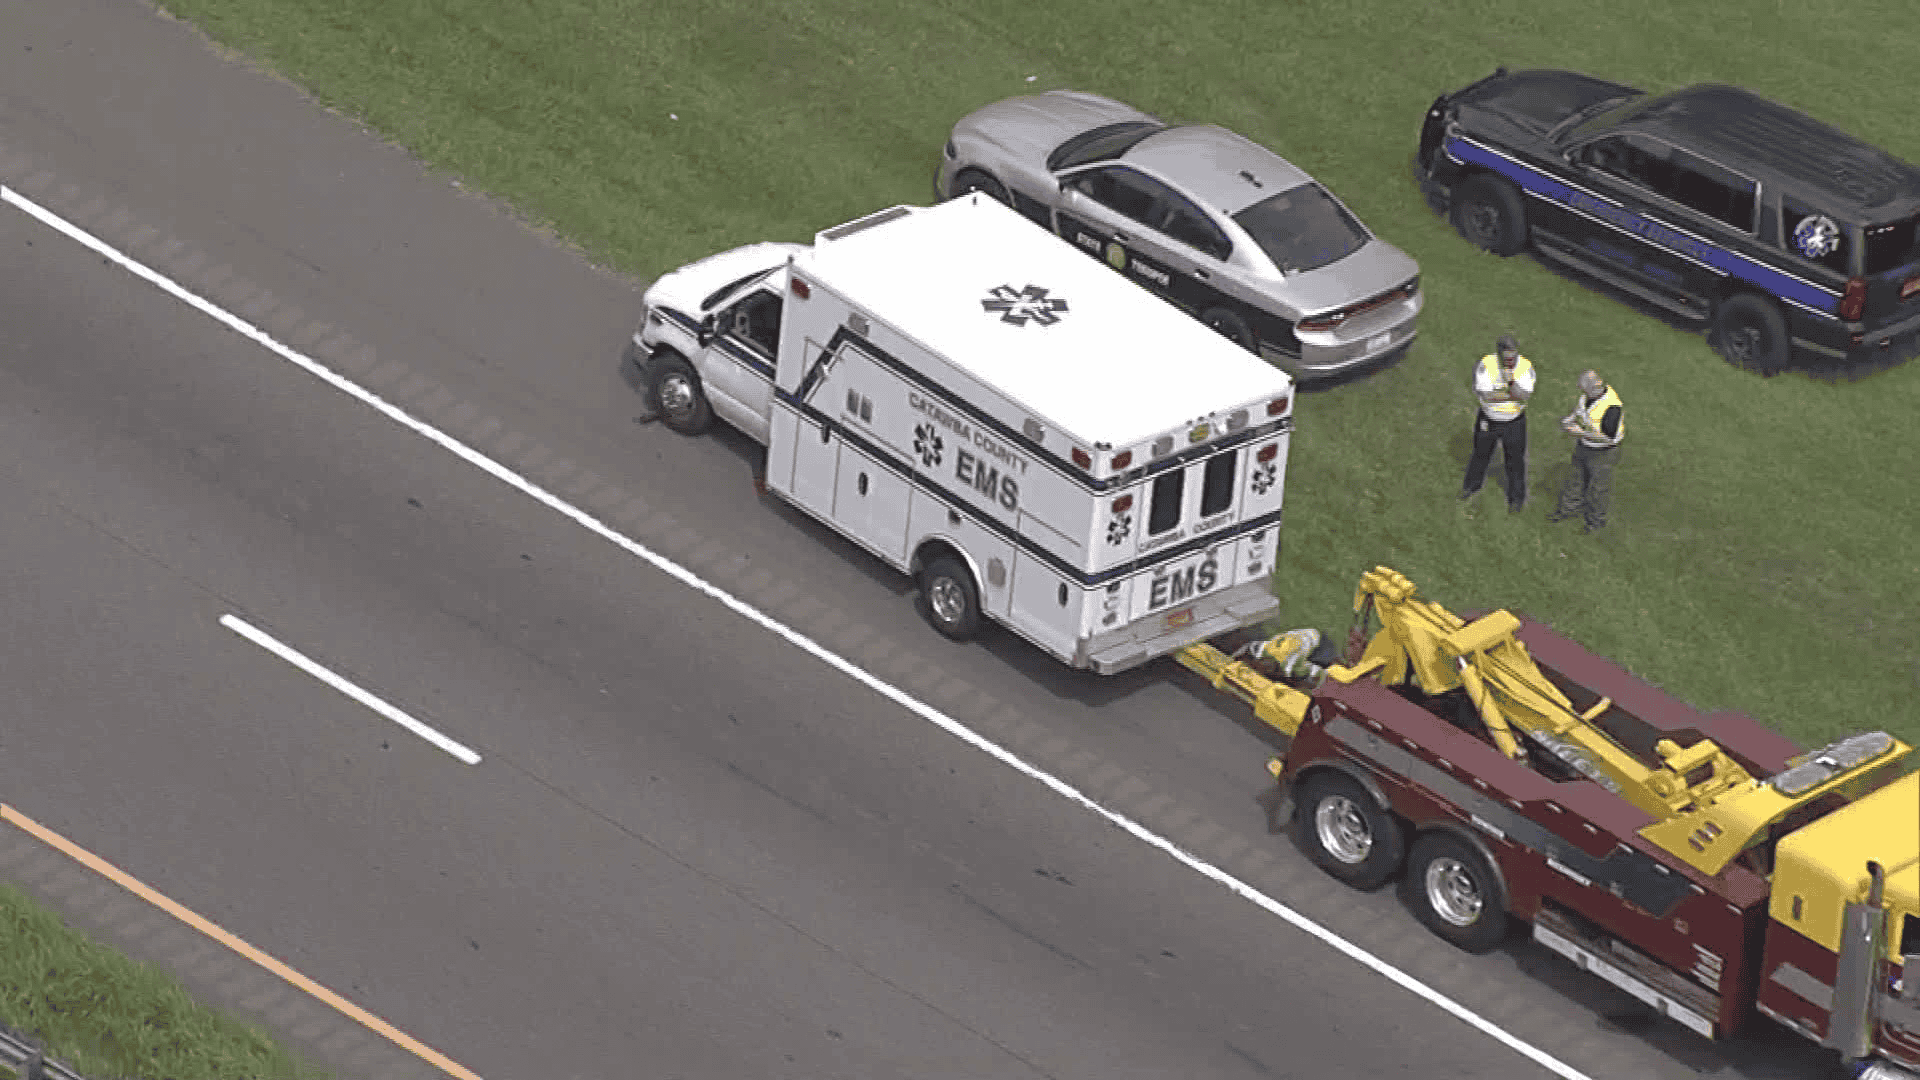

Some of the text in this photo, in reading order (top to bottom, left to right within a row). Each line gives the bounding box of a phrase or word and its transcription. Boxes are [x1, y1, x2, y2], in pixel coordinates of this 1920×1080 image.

[908, 391, 1028, 475] CATAWBA COUNTY
[955, 446, 1019, 512] EMS
[1193, 511, 1234, 534] COUNTY
[1150, 559, 1218, 610] EMS
